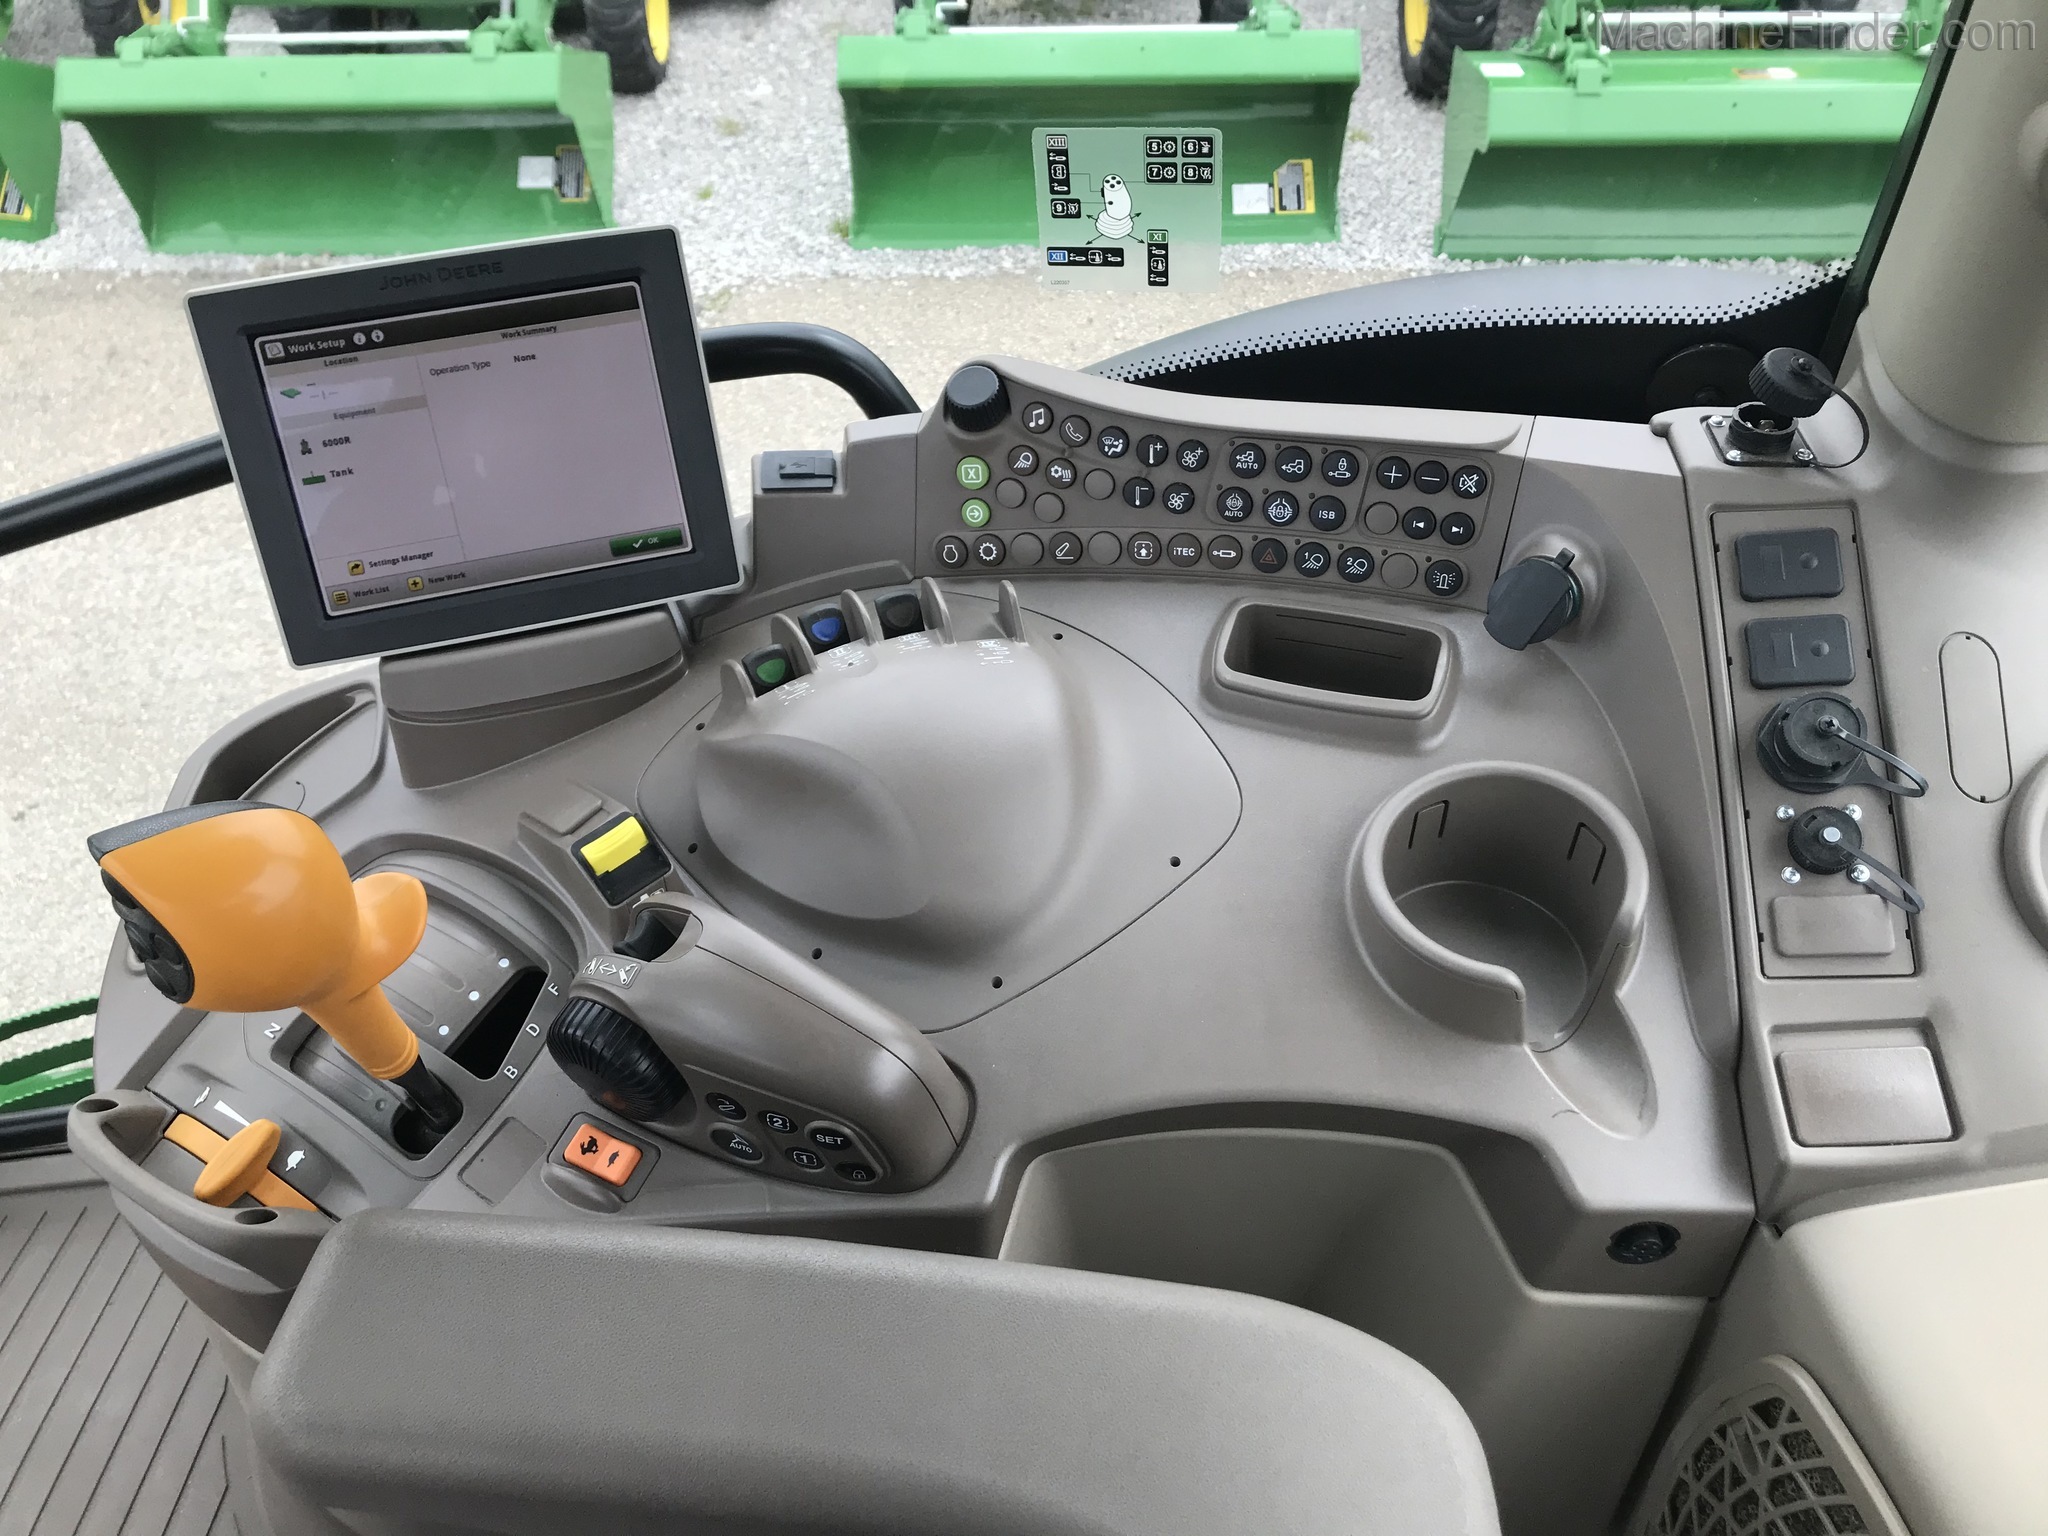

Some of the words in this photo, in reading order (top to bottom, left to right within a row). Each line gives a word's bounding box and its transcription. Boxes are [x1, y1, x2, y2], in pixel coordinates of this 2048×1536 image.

[1048, 138, 1066, 147] XIII
[1151, 142, 1158, 151] 5
[1187, 142, 1194, 151] 6
[1151, 167, 1158, 177] 7
[1187, 168, 1194, 177] 8
[1055, 204, 1063, 213] 9
[1152, 233, 1162, 242] XI
[1051, 252, 1064, 261] XII
[379, 271, 432, 291] JOHN
[436, 261, 503, 282] DEERE
[500, 329, 521, 340] Work
[521, 325, 557, 337] Summary
[287, 342, 316, 354] Work
[317, 339, 346, 350] Setup
[323, 356, 359, 367] Location
[429, 363, 470, 376] Operation
[471, 359, 491, 371] Type
[513, 353, 536, 363] None
[333, 407, 376, 421] Equipment
[1235, 461, 1258, 470] AUTO
[329, 467, 354, 478] Tank
[1223, 510, 1244, 518] AUTO
[1318, 510, 1336, 521] ISB
[647, 537, 660, 545] OK
[1173, 546, 1195, 557] iTEC
[368, 556, 400, 569] Settings
[401, 551, 434, 563] Manager
[547, 982, 559, 996] F
[264, 1022, 282, 1039] N
[525, 1023, 540, 1037] D
[503, 1065, 518, 1080] B
[772, 1117, 783, 1128] 2
[816, 1134, 844, 1145] SET
[729, 1142, 753, 1154] AUTO
